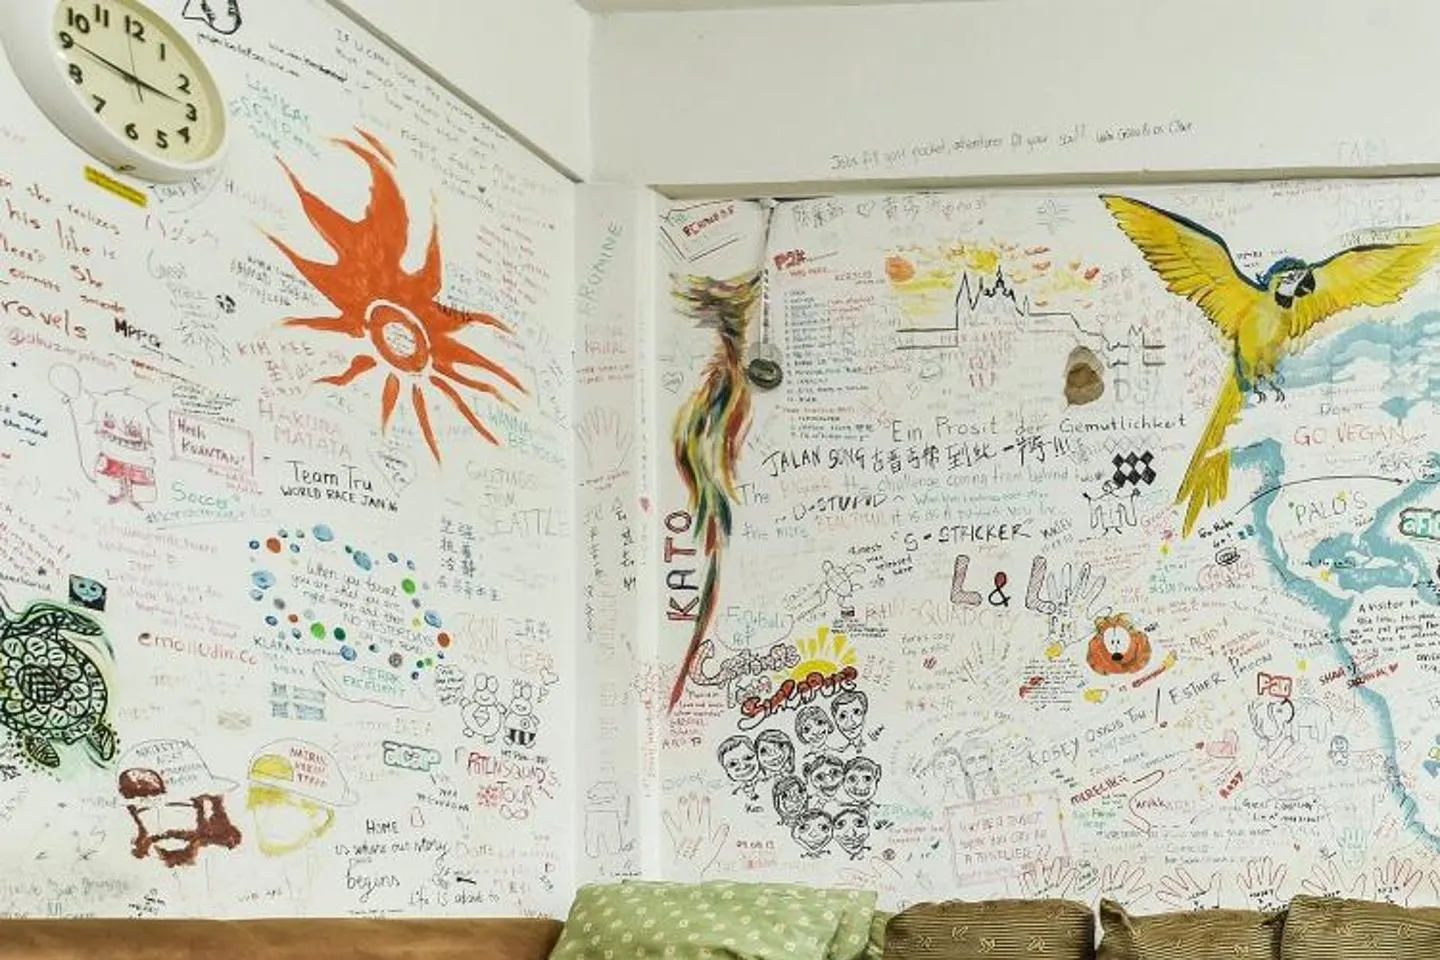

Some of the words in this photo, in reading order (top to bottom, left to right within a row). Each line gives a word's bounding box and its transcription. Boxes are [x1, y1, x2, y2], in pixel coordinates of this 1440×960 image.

[67, 8, 90, 33] 10
[95, 4, 108, 27] 11
[125, 15, 145, 42] 12
[59, 31, 73, 48] 9
[69, 63, 83, 84] 8
[178, 74, 190, 95] 2
[92, 94, 106, 113] 7
[186, 103, 197, 121] 3
[125, 123, 138, 140] 6
[156, 130, 168, 148] 5
[178, 126, 190, 143] 4
[892, 420, 923, 442] Ein
[935, 416, 999, 438] Prosit
[762, 449, 821, 477] JALAN
[286, 460, 339, 486] Team
[342, 464, 372, 490] Tru
[280, 485, 322, 501] WORLD
[327, 489, 356, 504] RACE
[664, 510, 699, 620] KATO
[951, 555, 982, 606] L
[988, 572, 1011, 607] &
[366, 818, 400, 834] HOME
